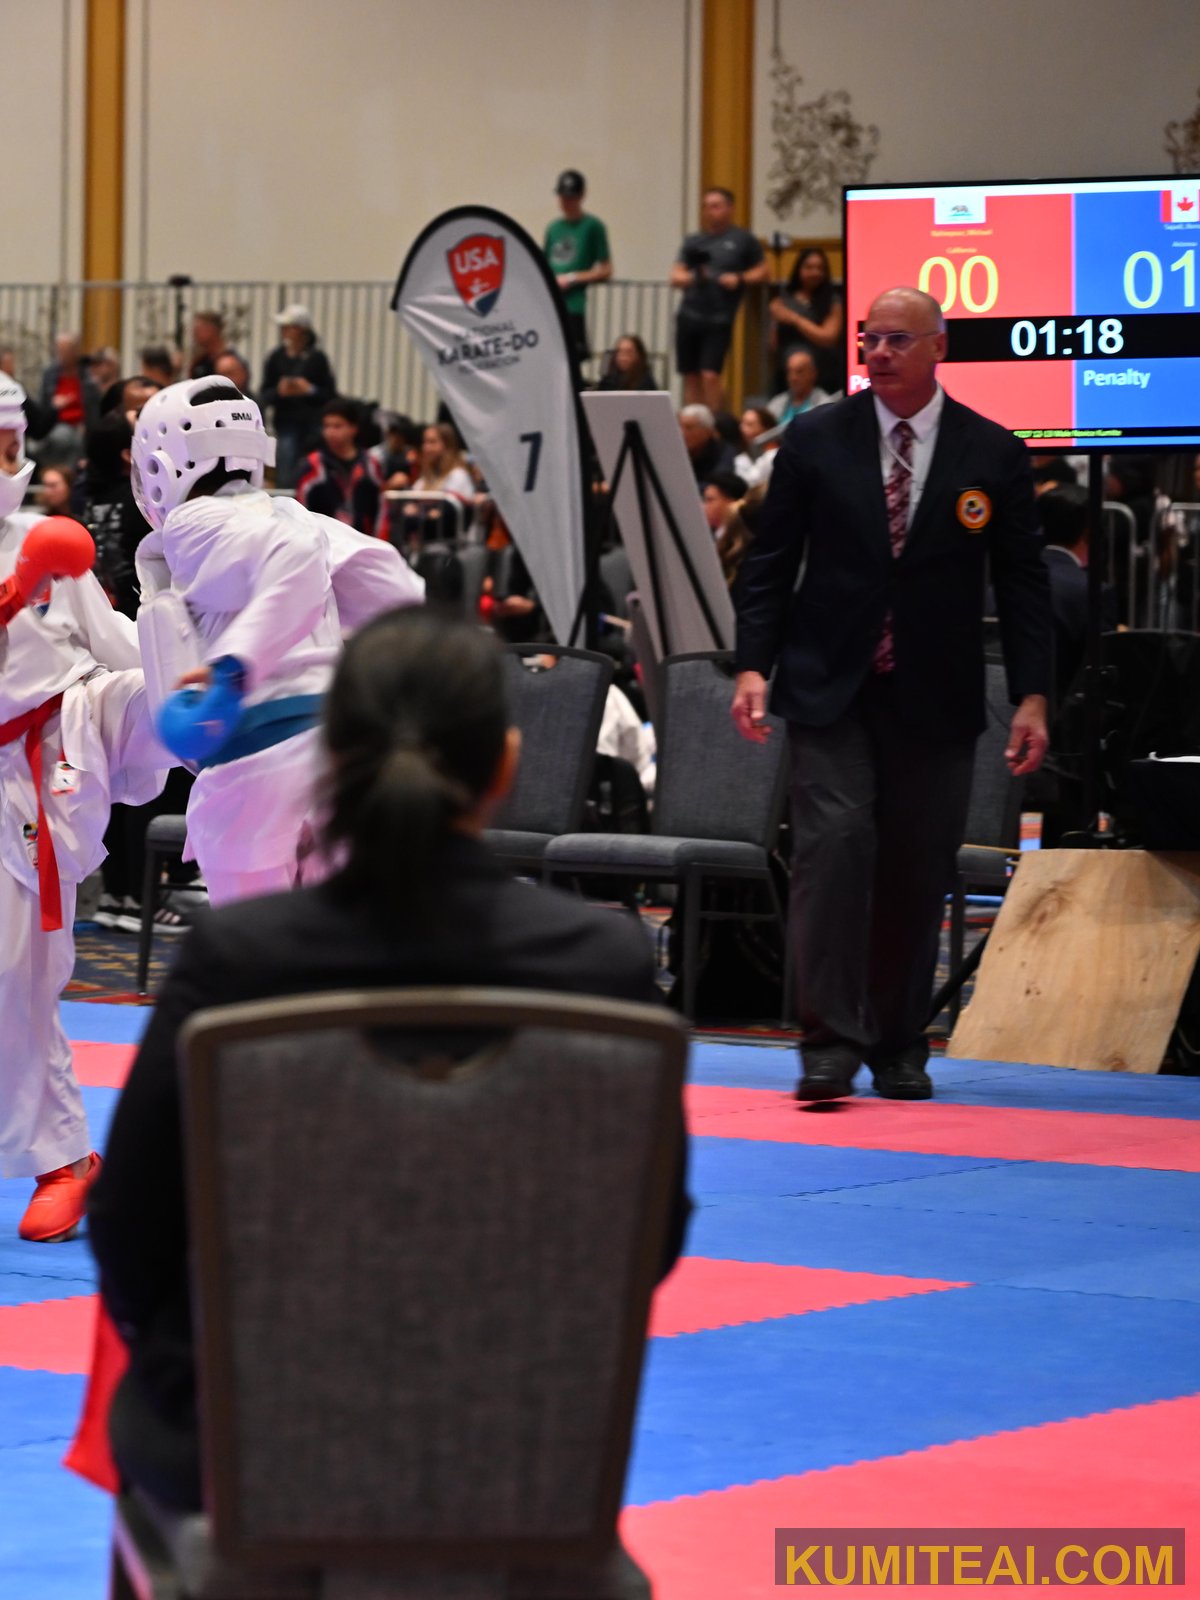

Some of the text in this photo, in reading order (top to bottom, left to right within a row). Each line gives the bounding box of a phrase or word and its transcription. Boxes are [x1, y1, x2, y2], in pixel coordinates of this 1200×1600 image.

[453, 246, 499, 273] USA
[1123, 250, 1195, 309] 01
[1011, 318, 1124, 357] 01:18
[1083, 368, 1151, 388] Penalty
[519, 431, 542, 492] 7
